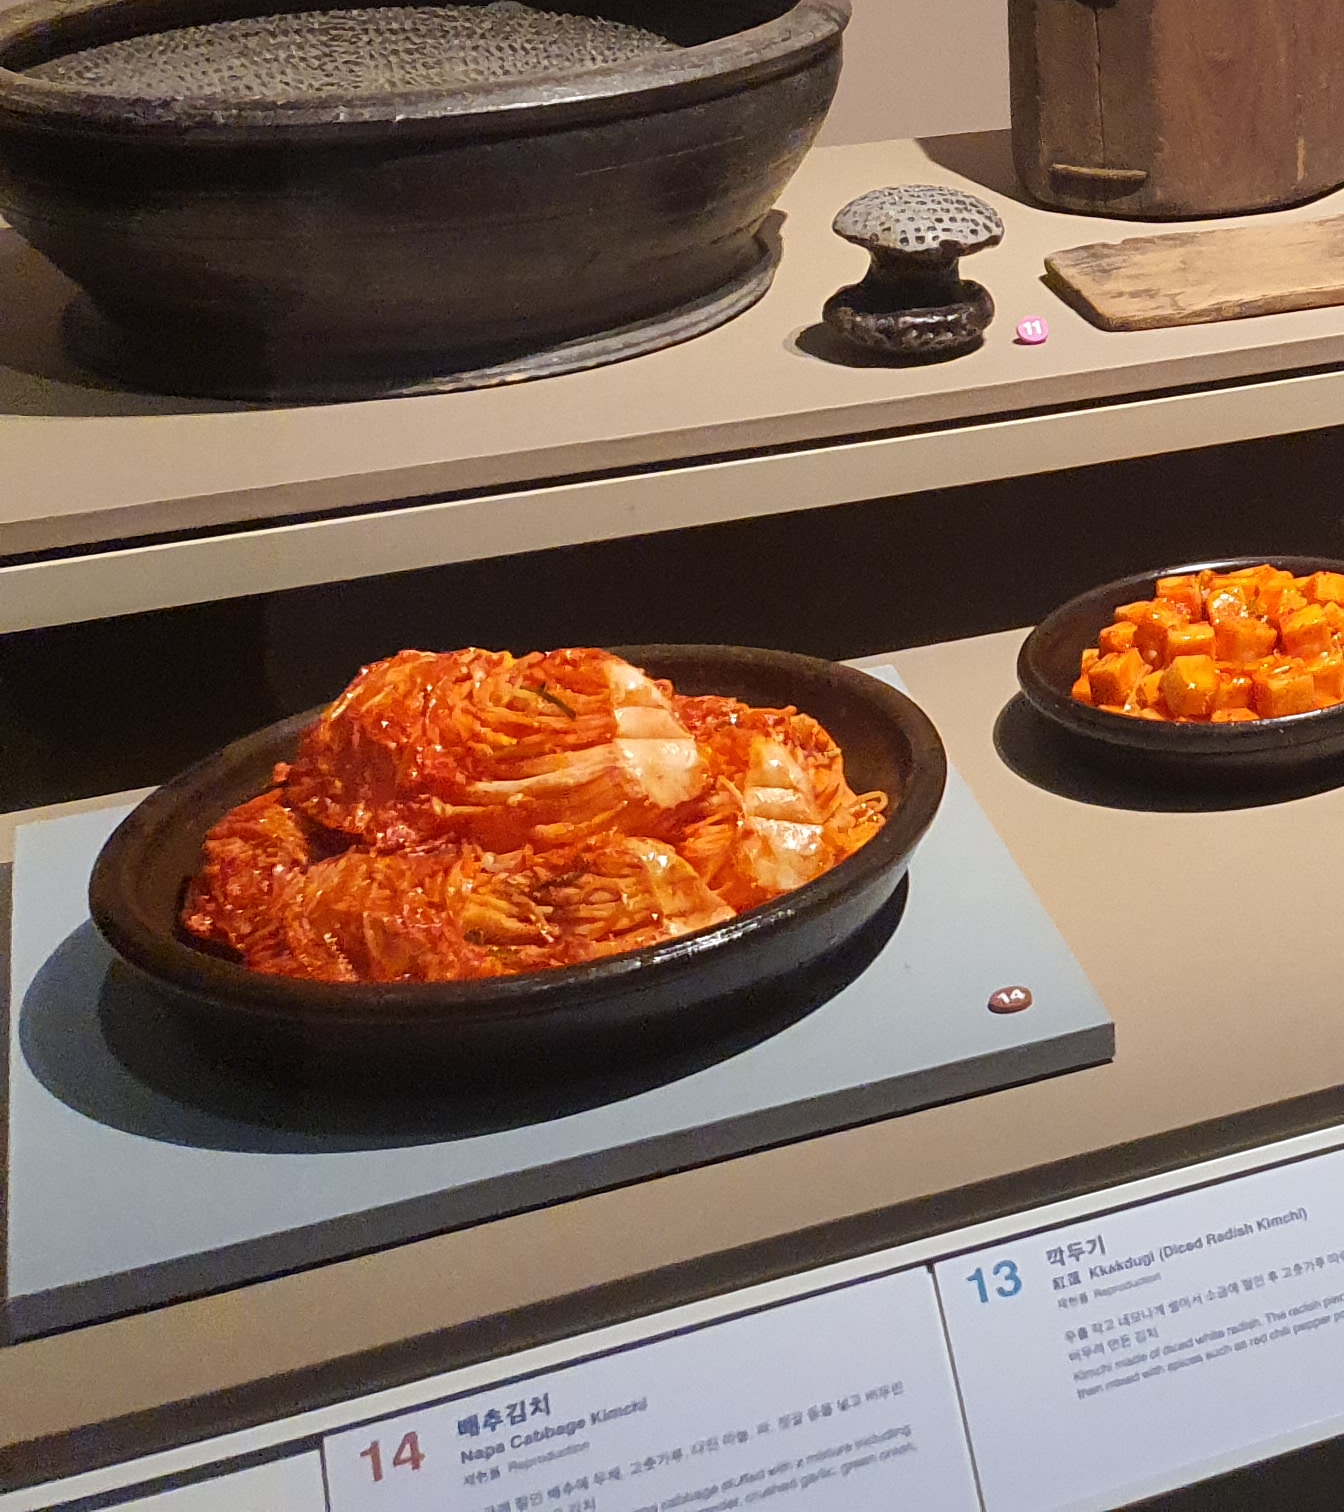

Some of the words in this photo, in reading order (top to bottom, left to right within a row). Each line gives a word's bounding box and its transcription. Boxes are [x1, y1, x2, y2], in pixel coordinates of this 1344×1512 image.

[1045, 1234, 1105, 1266] 깍두기
[965, 1259, 1022, 1303] 13
[457, 1391, 550, 1438] 배추김치
[359, 1430, 425, 1482] 14
